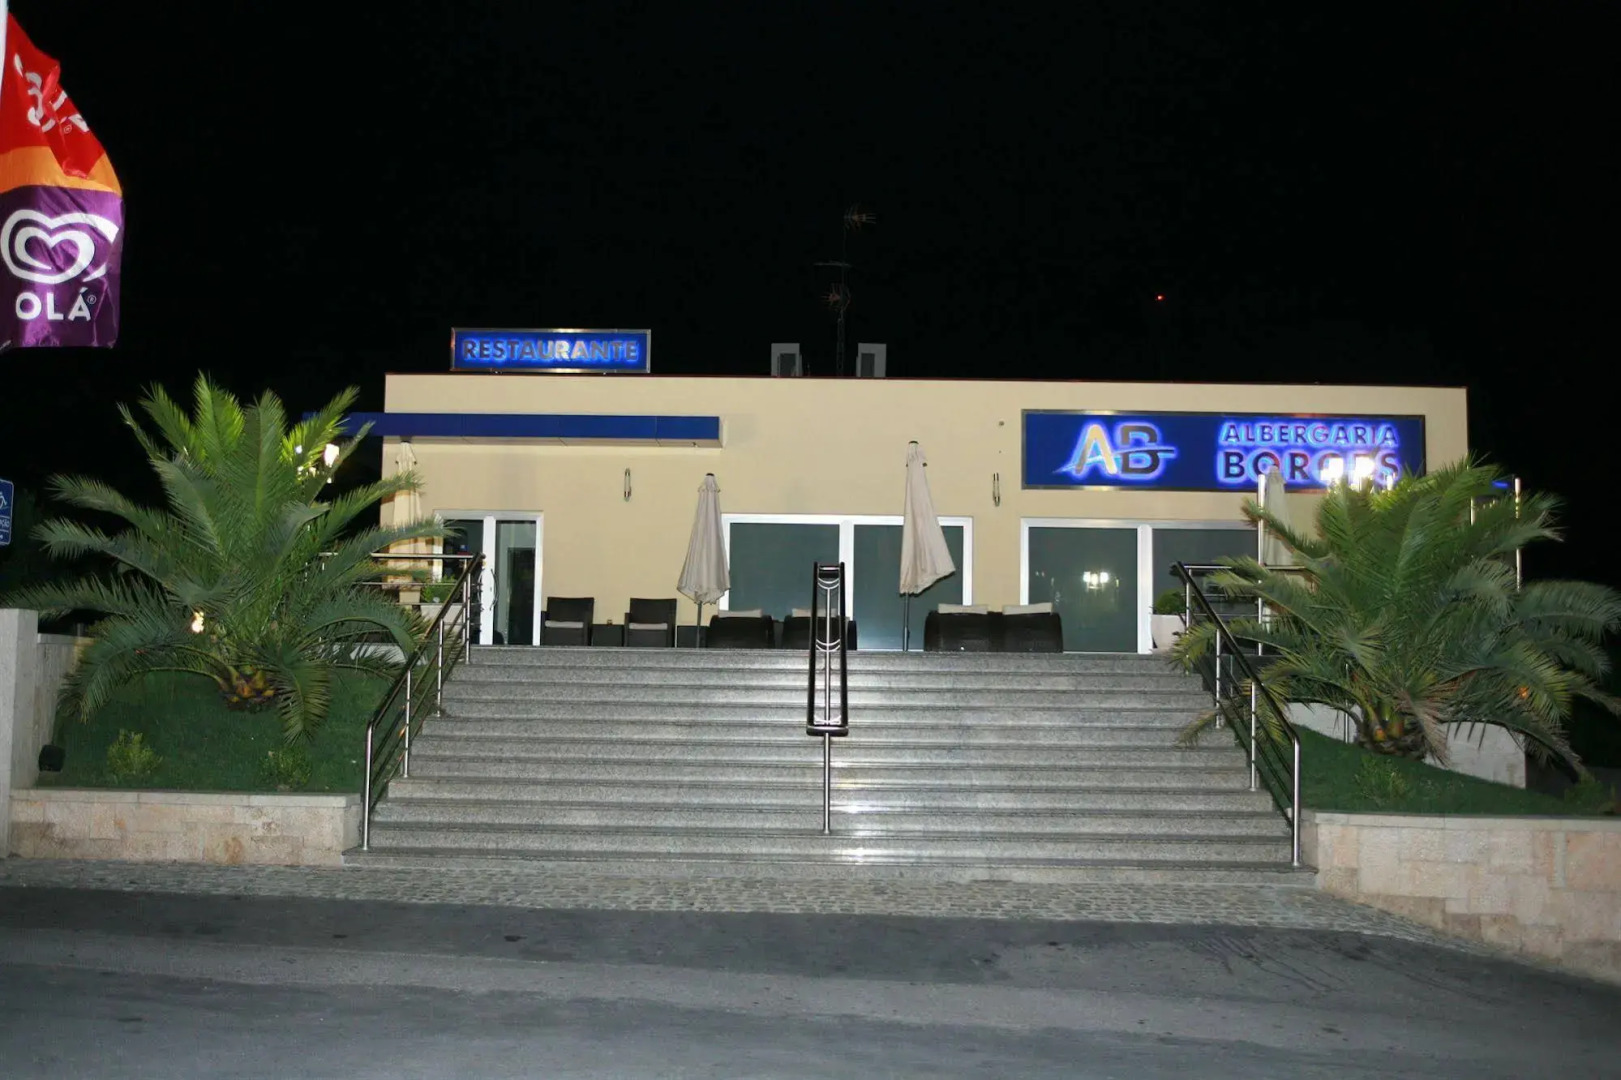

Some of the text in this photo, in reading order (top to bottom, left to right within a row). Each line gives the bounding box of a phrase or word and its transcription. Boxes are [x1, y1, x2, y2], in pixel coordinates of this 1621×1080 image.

[461, 339, 639, 360] RESTAURANTE
[1222, 423, 1399, 446] ALBERGARIA
[1068, 423, 1166, 475] AB
